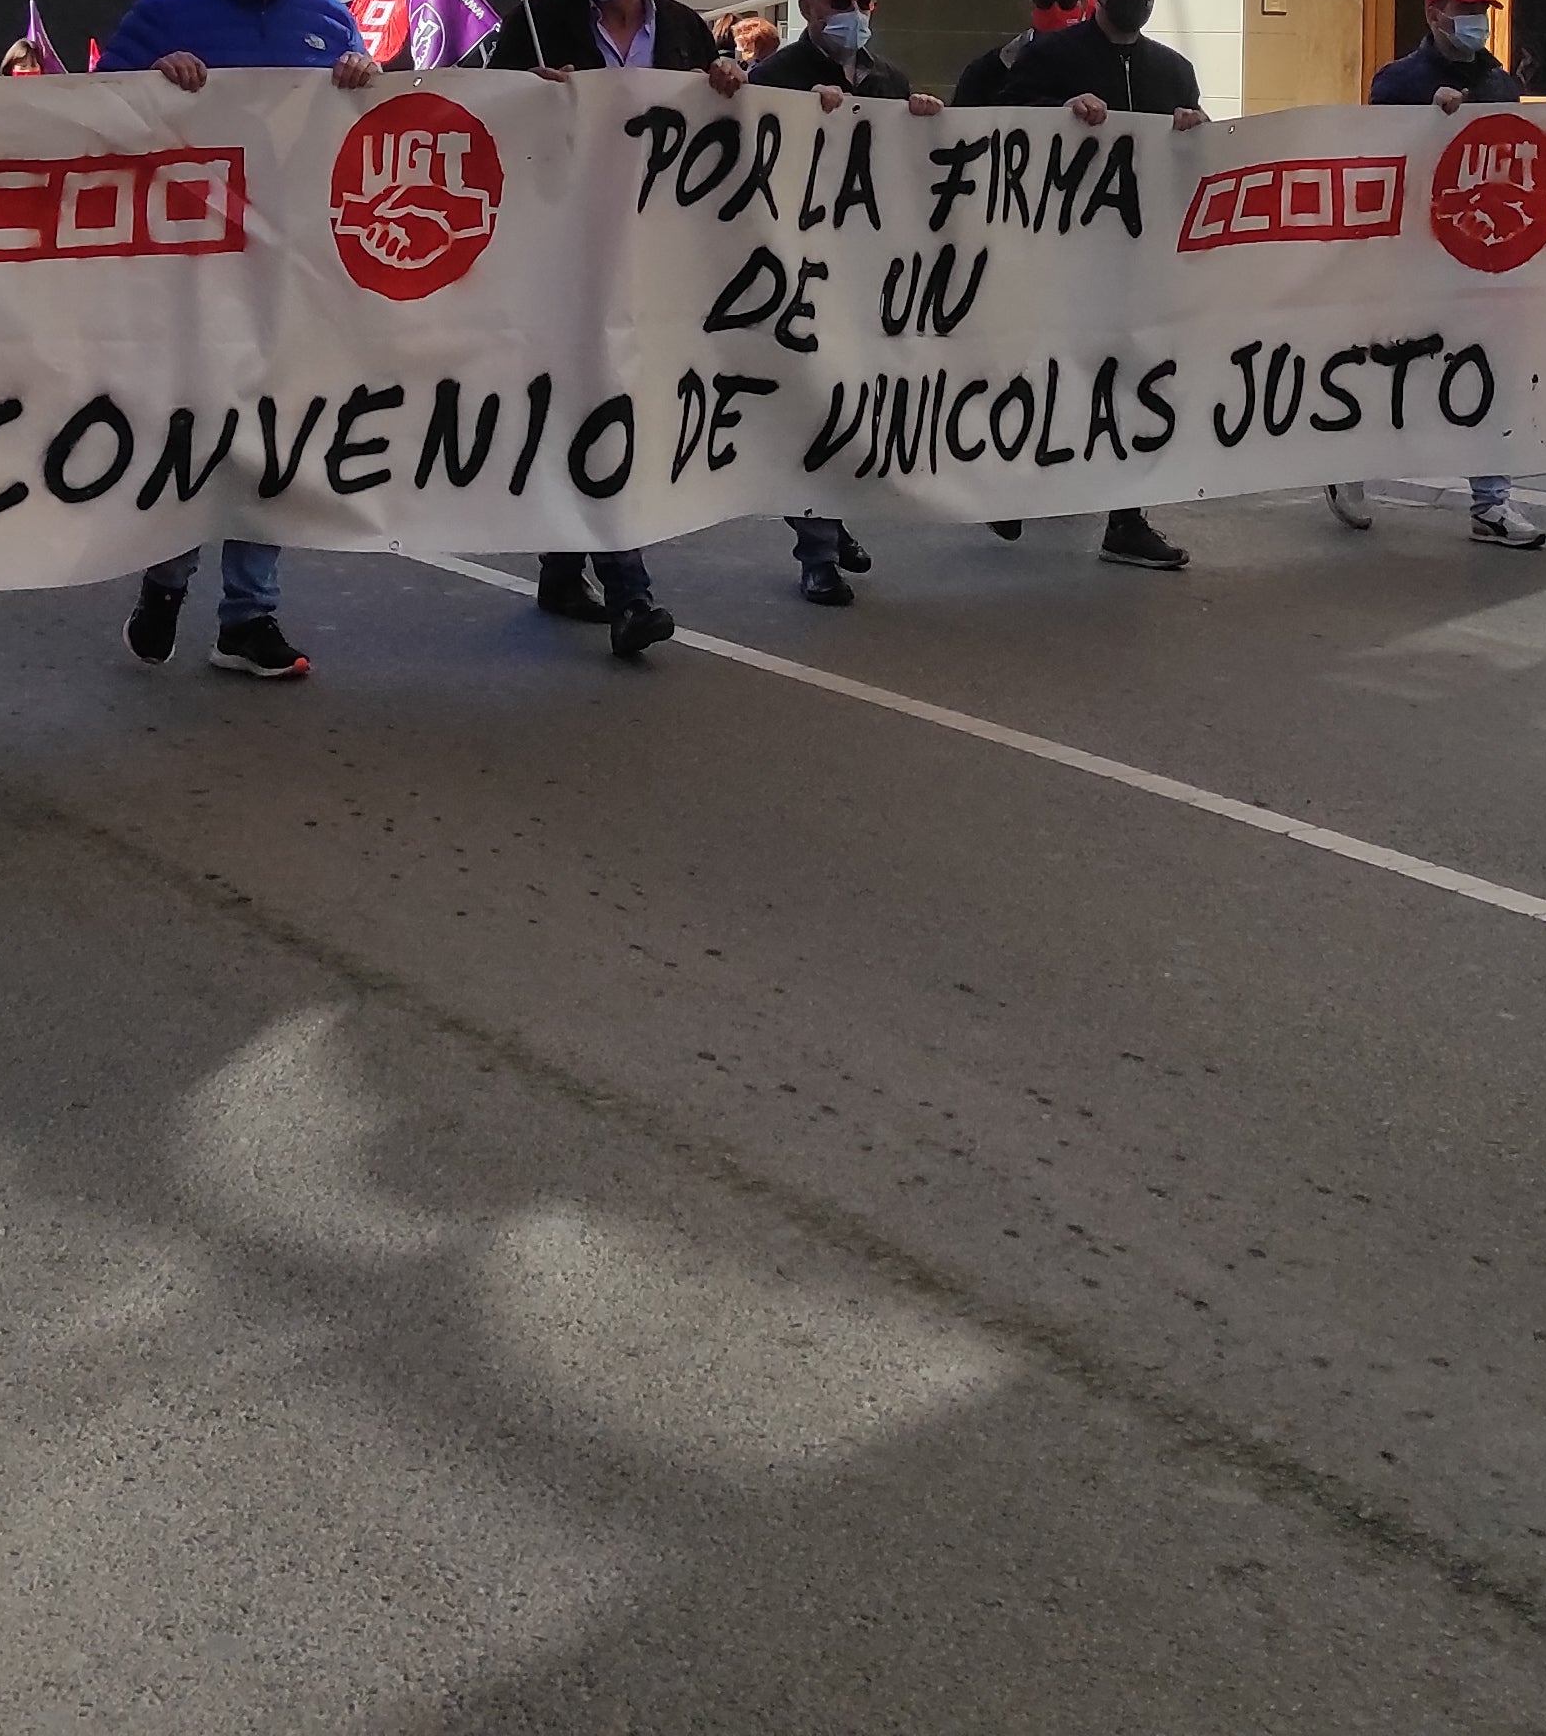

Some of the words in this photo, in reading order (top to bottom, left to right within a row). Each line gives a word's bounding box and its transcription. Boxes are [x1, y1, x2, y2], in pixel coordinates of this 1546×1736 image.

[361, 130, 472, 189] UGT
[624, 106, 780, 221] POR
[798, 119, 881, 231] LA
[929, 128, 1143, 238] FIRMA
[1188, 166, 1398, 240] CCOO
[1457, 140, 1538, 191] UGT
[703, 246, 829, 352] DE
[880, 243, 989, 338] UN
[669, 368, 780, 484] DE
[1213, 333, 1496, 448] JUSTO
